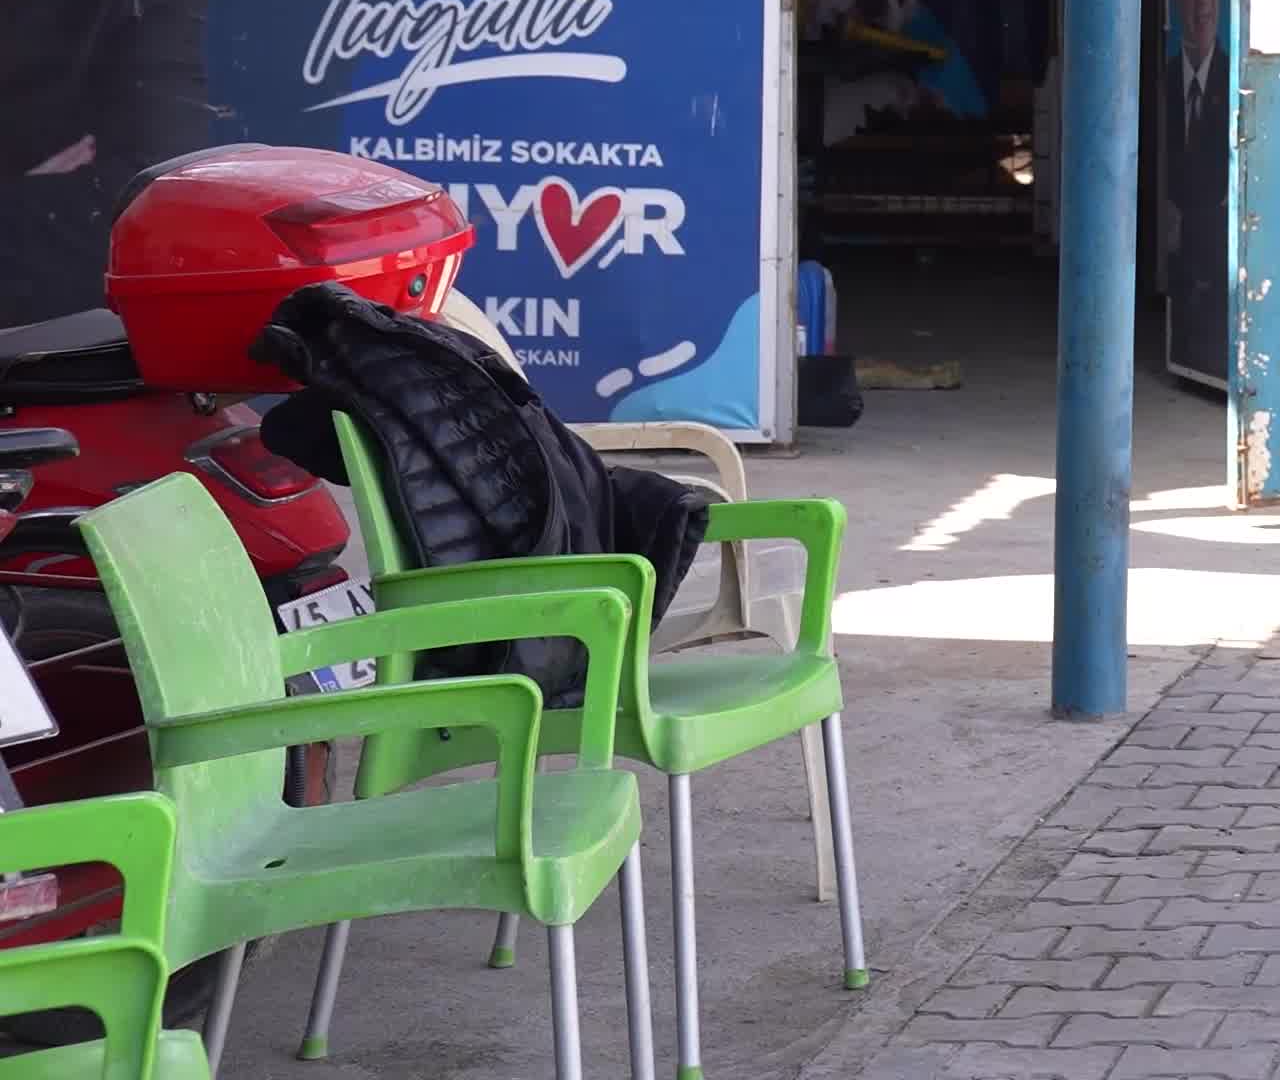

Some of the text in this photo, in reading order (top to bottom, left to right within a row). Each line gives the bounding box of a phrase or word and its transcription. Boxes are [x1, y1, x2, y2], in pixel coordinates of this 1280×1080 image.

[349, 133, 665, 168] KALBİMİZ SOKAKTA
[485, 296, 580, 338] KIN
